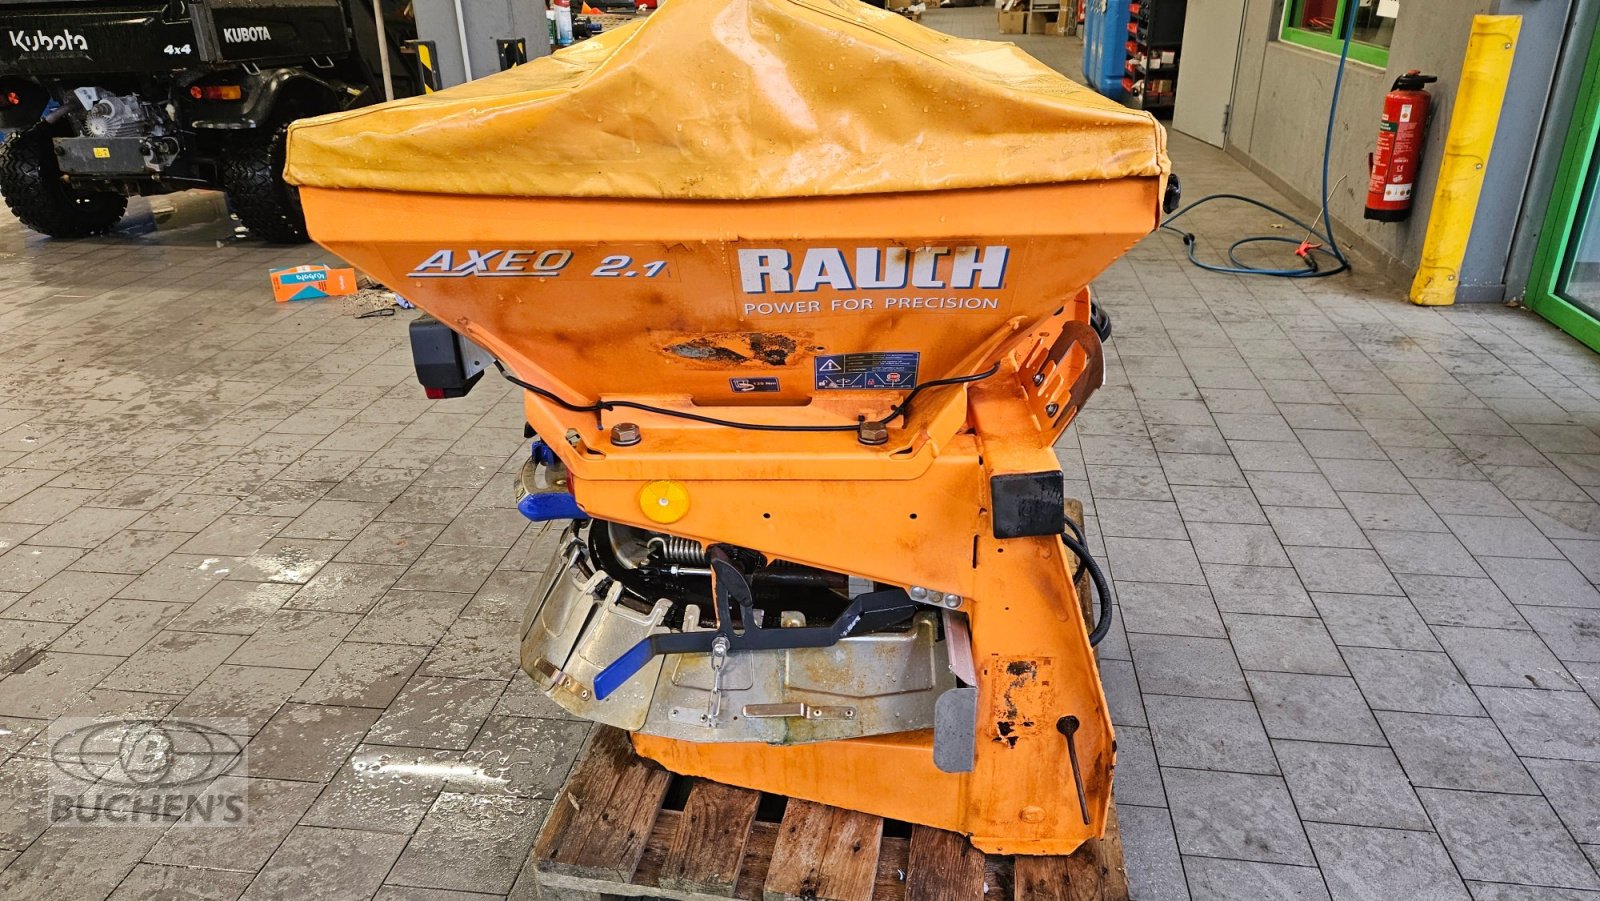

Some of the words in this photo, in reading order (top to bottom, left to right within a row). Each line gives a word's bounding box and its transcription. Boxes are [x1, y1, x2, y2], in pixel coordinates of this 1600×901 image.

[9, 29, 89, 52] Kubota
[223, 26, 272, 44] KUBOTA
[163, 44, 192, 55] 4x4
[408, 249, 574, 278] AXEO
[591, 255, 669, 279] 2.1
[737, 245, 1010, 294] RAUCH
[744, 300, 821, 315] POWER
[831, 298, 874, 311] FOR
[885, 297, 999, 310] PRECISION
